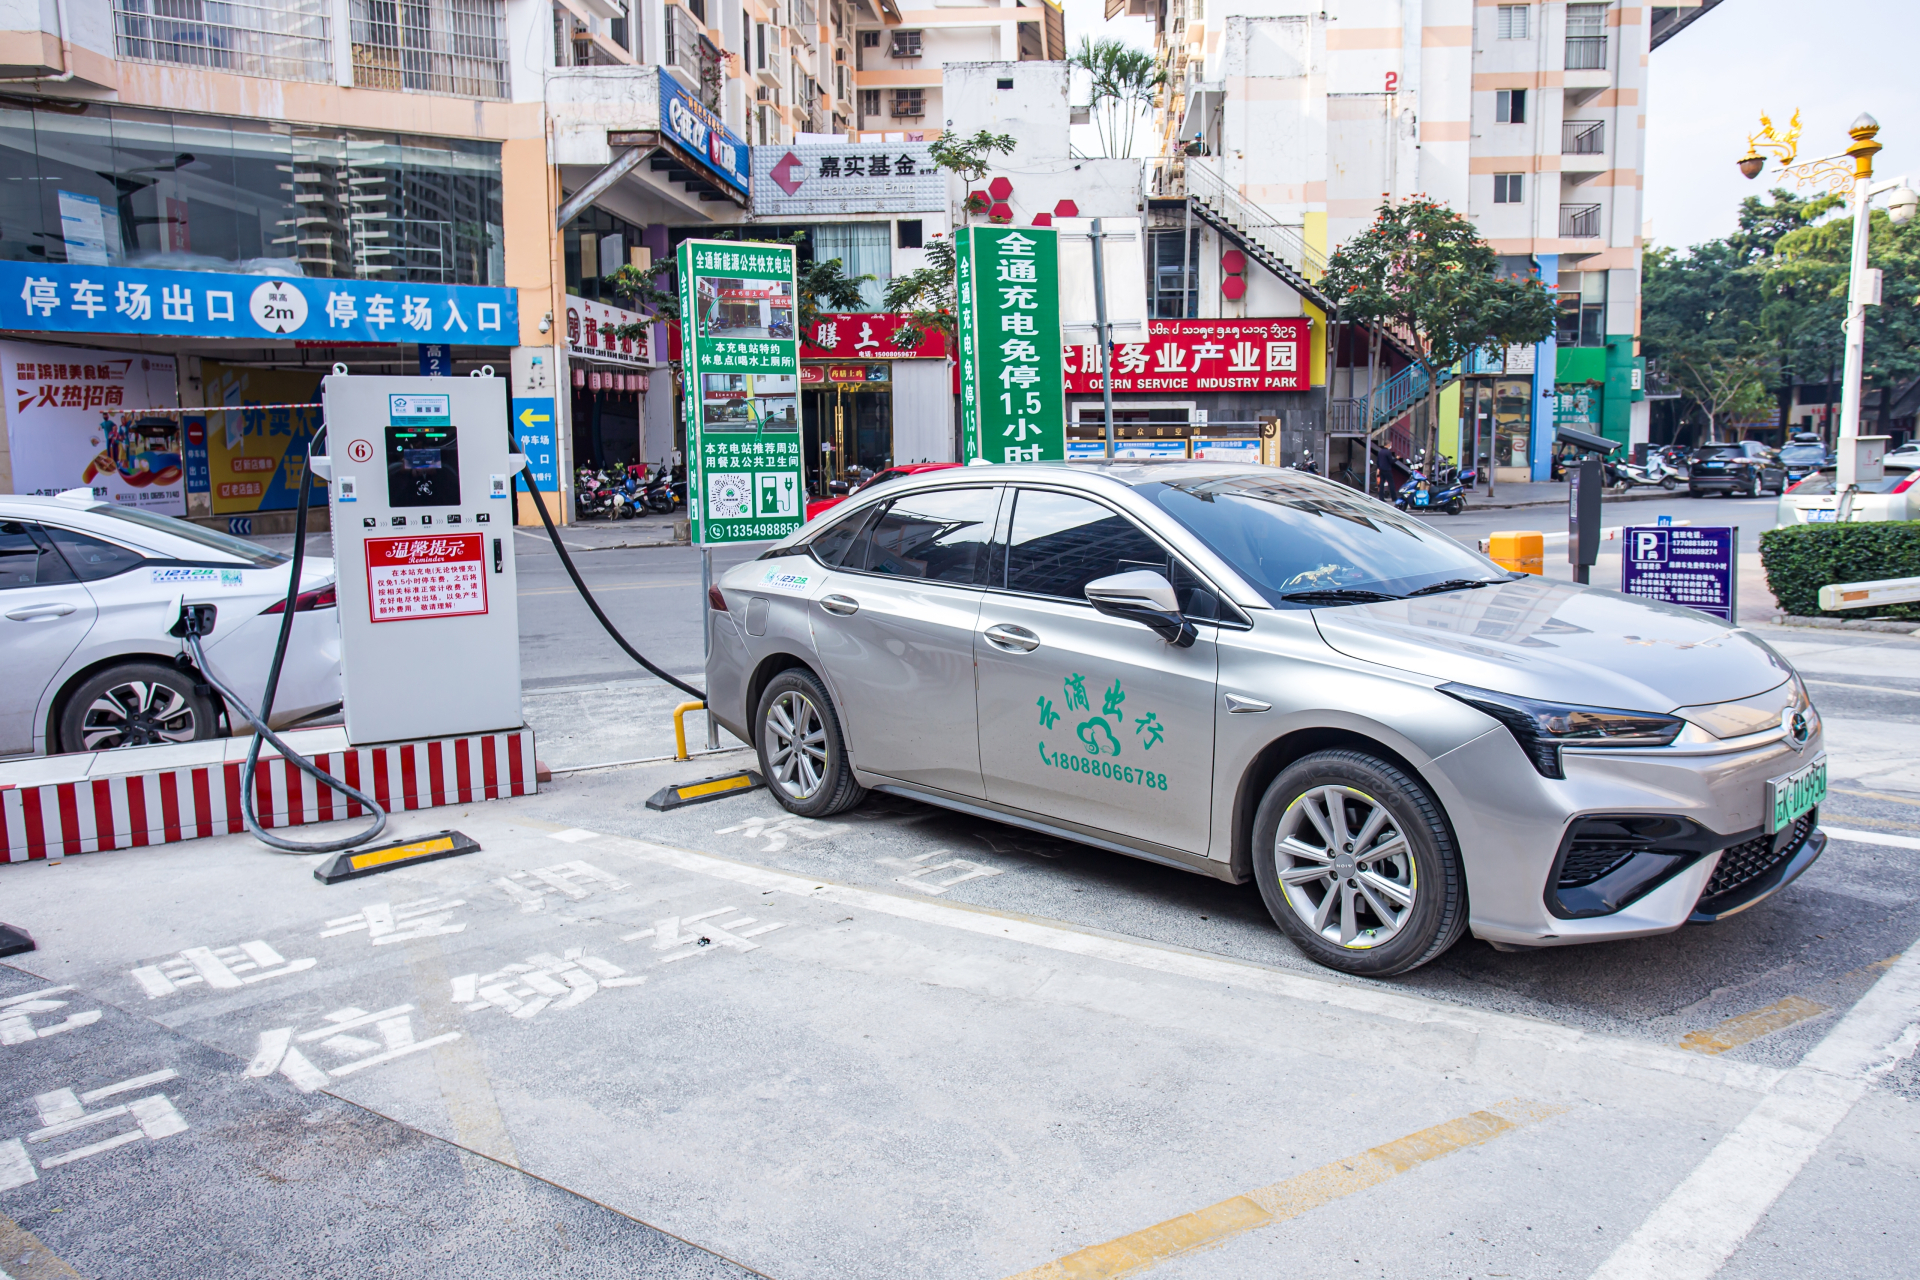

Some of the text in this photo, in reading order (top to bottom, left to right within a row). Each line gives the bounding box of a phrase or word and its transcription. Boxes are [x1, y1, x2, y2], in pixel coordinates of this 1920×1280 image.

[819, 153, 917, 178] 嘉实基金
[821, 180, 916, 197] Harvest Fnud
[695, 250, 792, 275] 全通新能源公共快充电站
[20, 276, 236, 323] 停车场出口
[268, 293, 288, 303] 限高
[263, 303, 295, 321] 2m
[325, 291, 502, 333] 停车场入口
[714, 341, 781, 355] 本充电站特约
[995, 231, 1045, 464] 全通充电免停1.5小时
[701, 354, 795, 367] 休息点(喝水上厕所)
[960, 256, 976, 463] 全通充电免停1.5小
[37, 362, 112, 381] 滨港美食城
[1137, 378, 1189, 389] SERVICE
[1197, 377, 1260, 389] INDUSTRY
[1265, 377, 1298, 388] PARK
[36, 384, 125, 412] 火热招商
[1097, 427, 1202, 437] 国家众创空间
[520, 435, 550, 446] 停车场
[704, 442, 799, 455] 本充电站推荐周边
[187, 449, 207, 459] 停车场
[355, 443, 366, 458] 6
[705, 456, 799, 469] 用餐及公共卫生间
[725, 522, 800, 538] 13354988858
[385, 539, 466, 558] 温馨提示
[408, 556, 445, 564] Reminder
[1050, 751, 1168, 791] 18088066788
